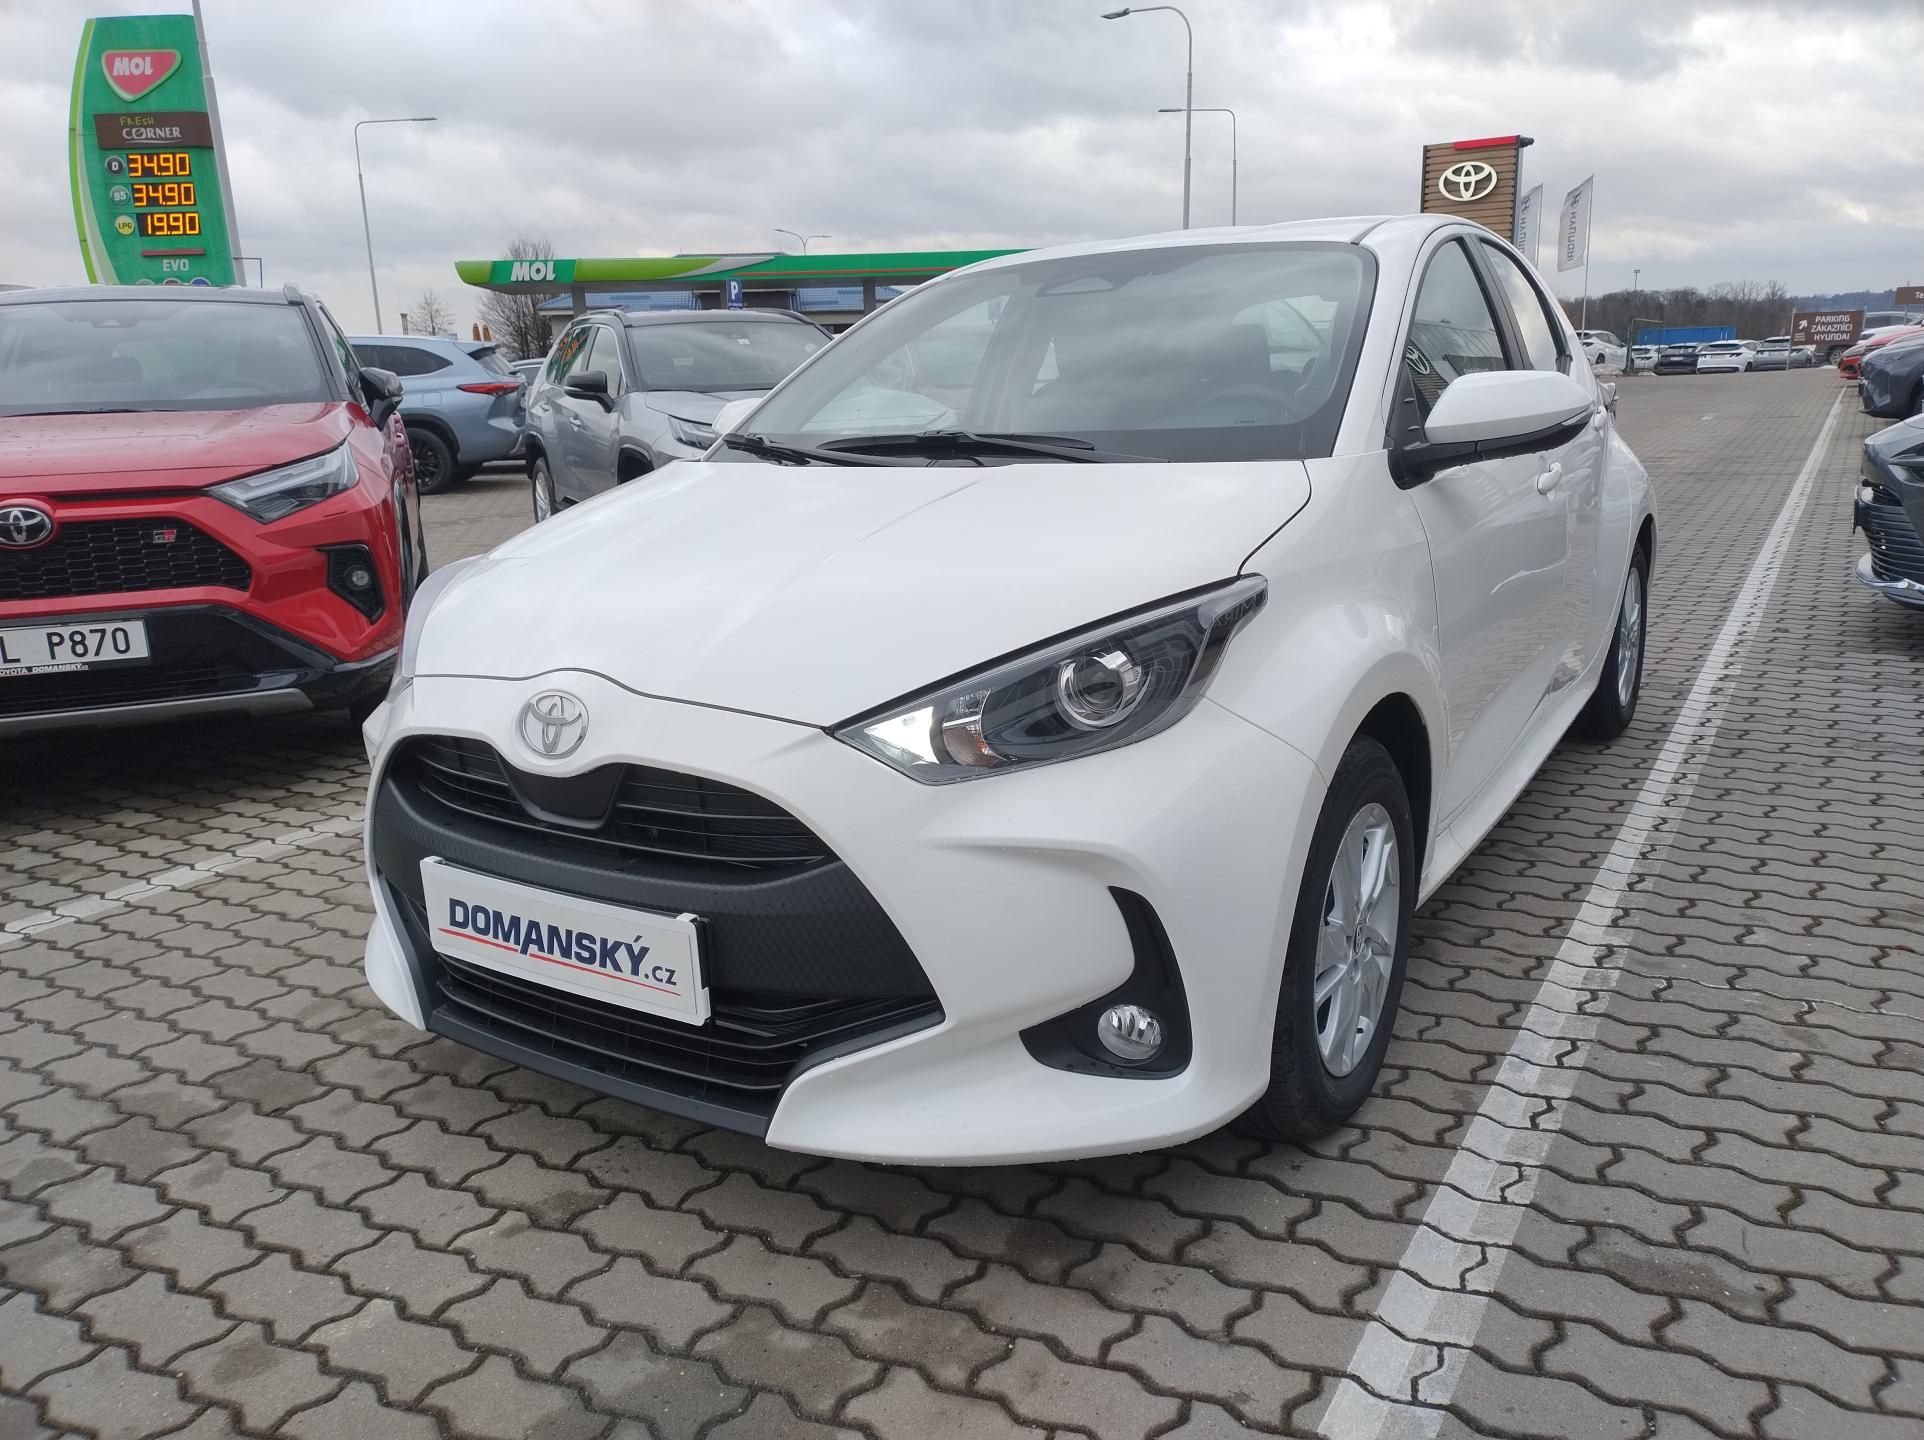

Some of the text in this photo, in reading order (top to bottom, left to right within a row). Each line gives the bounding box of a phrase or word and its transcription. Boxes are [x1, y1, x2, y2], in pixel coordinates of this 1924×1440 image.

[112, 56, 154, 76] MOL
[120, 116, 154, 126] FRESH
[111, 153, 190, 176] D 34.90
[113, 183, 195, 206] 95 34.90
[118, 212, 200, 235] LPG 19.90
[162, 259, 189, 272] EVO
[511, 261, 556, 281] MOL
[730, 281, 739, 300] P
[1811, 323, 1852, 333] ZÁKAZNÍCI
[1815, 314, 1850, 324] PARKING
[1814, 332, 1850, 341] HYUNDAI
[45, 626, 131, 660] P870
[449, 897, 678, 986] DOMANSKÝ.cz
